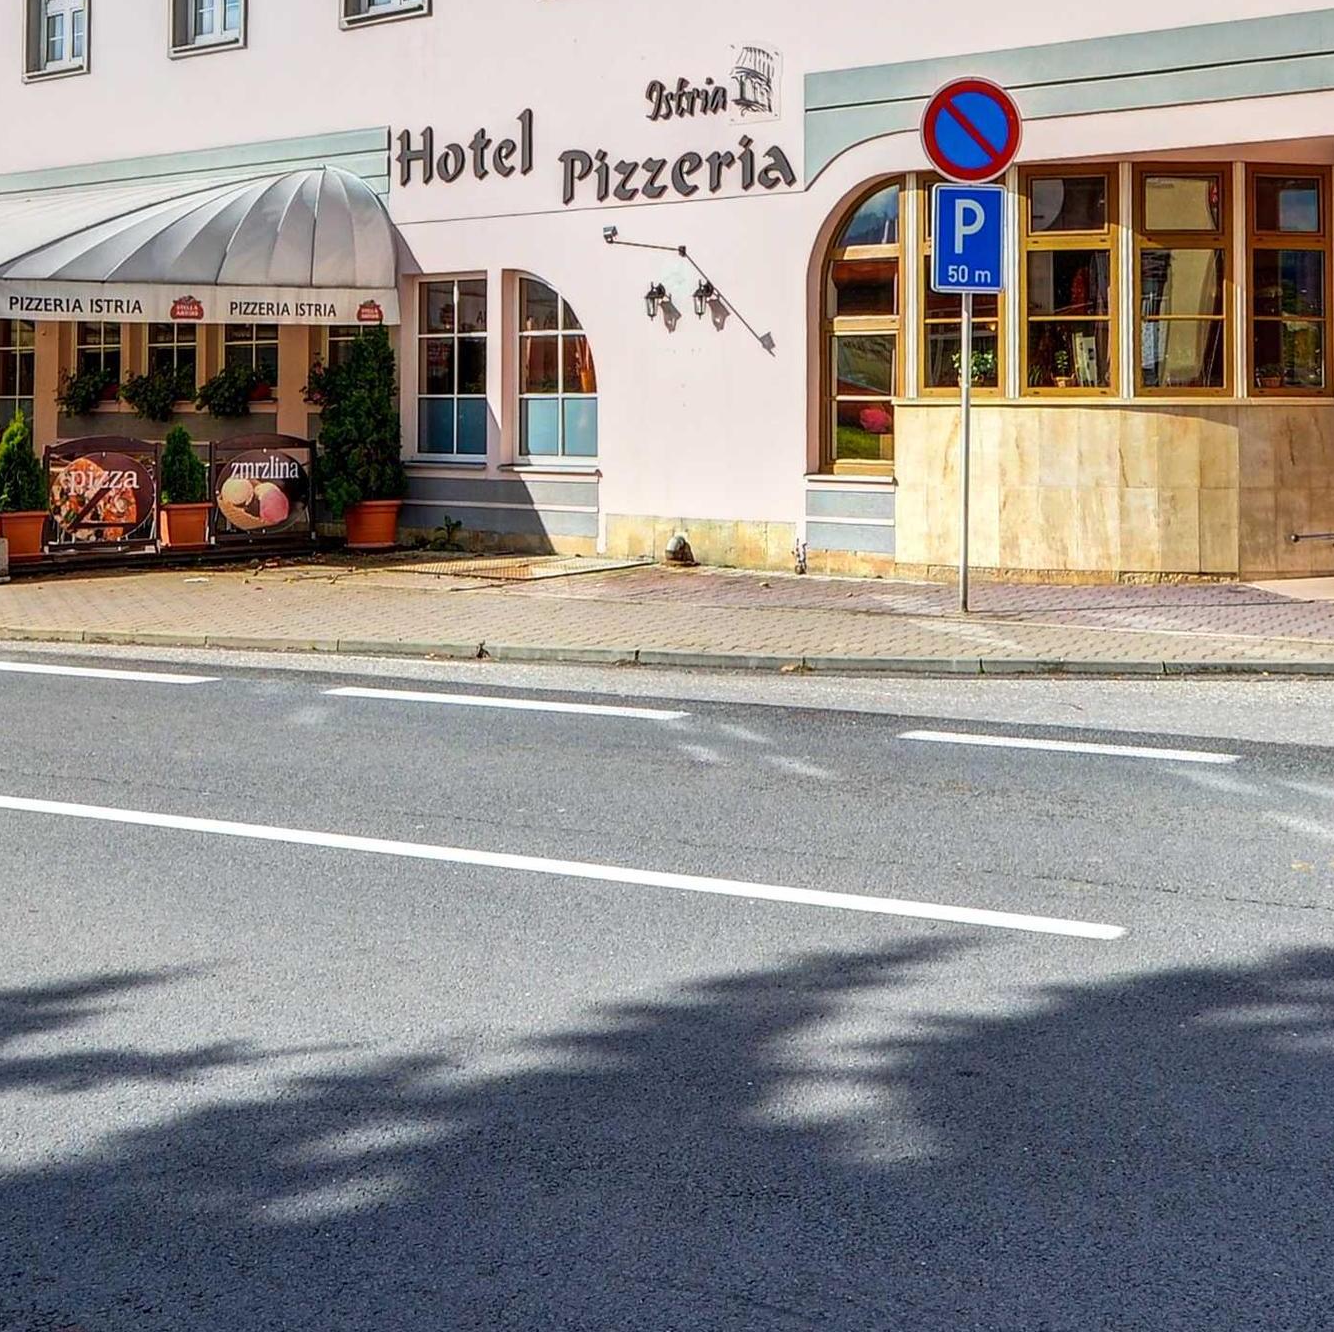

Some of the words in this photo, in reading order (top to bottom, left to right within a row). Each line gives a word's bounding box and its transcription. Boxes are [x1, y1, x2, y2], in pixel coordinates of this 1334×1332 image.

[395, 108, 534, 187] Hotel
[558, 134, 798, 206] Pizzeria
[954, 199, 985, 254] P
[948, 265, 969, 283] 50
[974, 270, 991, 283] m
[9, 295, 82, 314] PIZZERIA
[89, 298, 143, 315] ISTRIA
[229, 300, 290, 317] PIZZERIA
[295, 302, 337, 318] ISTRIA
[69, 466, 140, 496] pizza
[231, 455, 300, 480] zmrzlina
